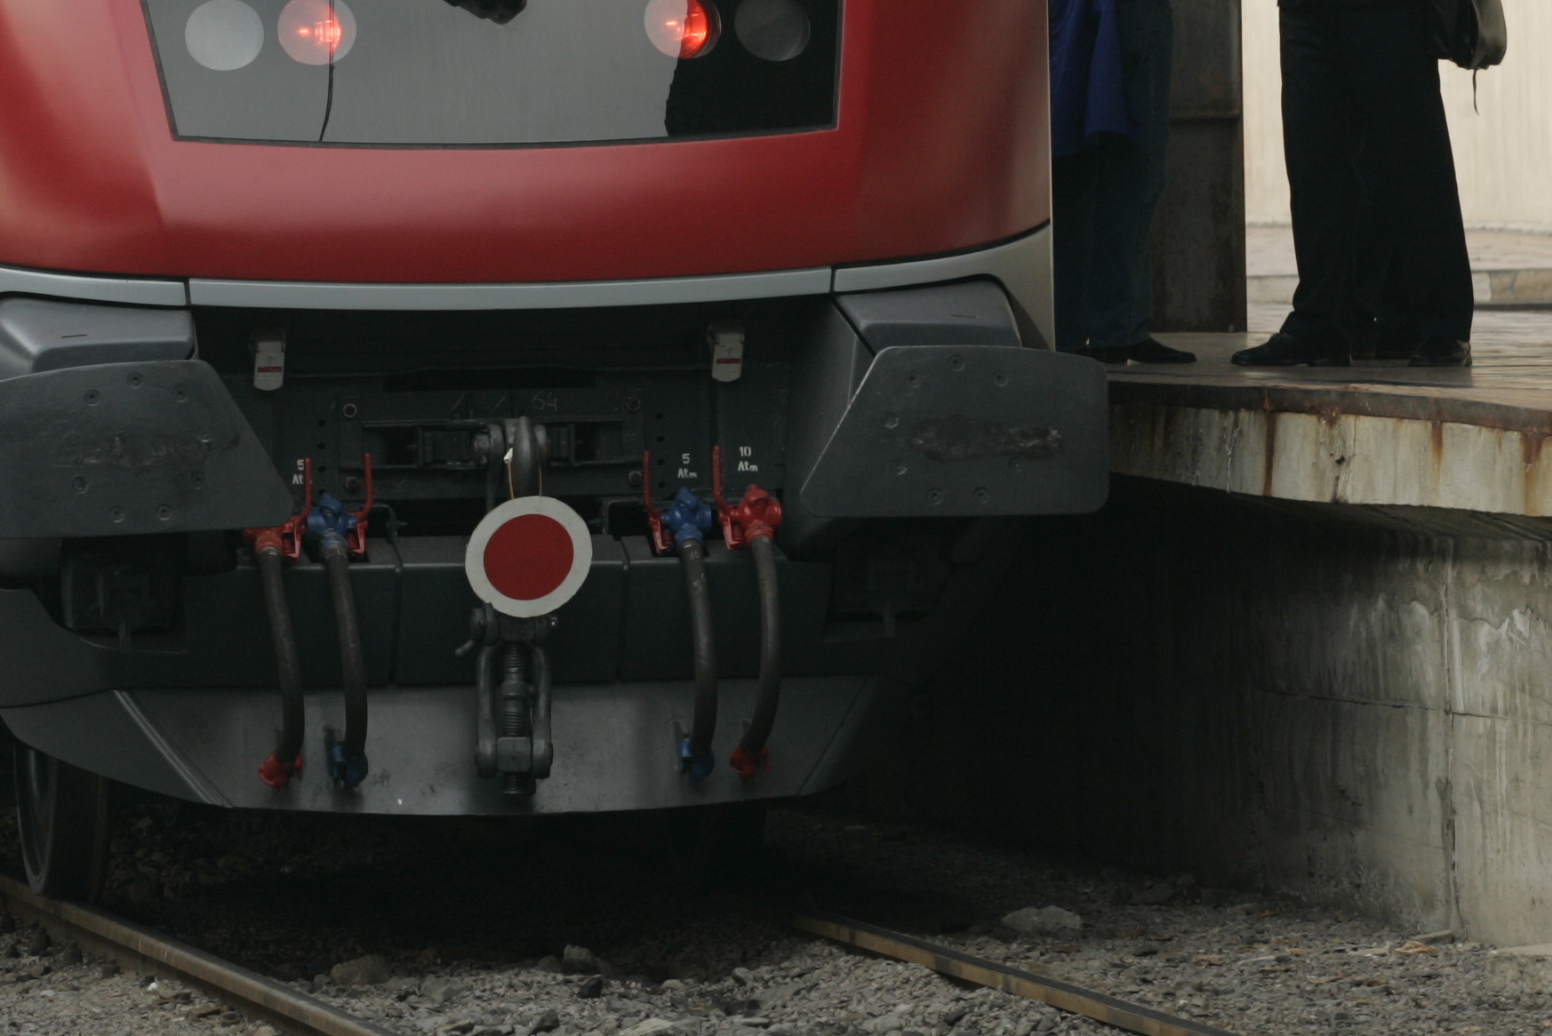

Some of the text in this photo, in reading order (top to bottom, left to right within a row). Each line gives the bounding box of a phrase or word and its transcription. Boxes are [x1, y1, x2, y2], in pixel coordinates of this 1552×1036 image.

[738, 446, 752, 457] 10
[681, 453, 691, 464] 5
[296, 459, 305, 471] 5
[737, 460, 758, 472] Atm
[677, 467, 697, 479] Atm
